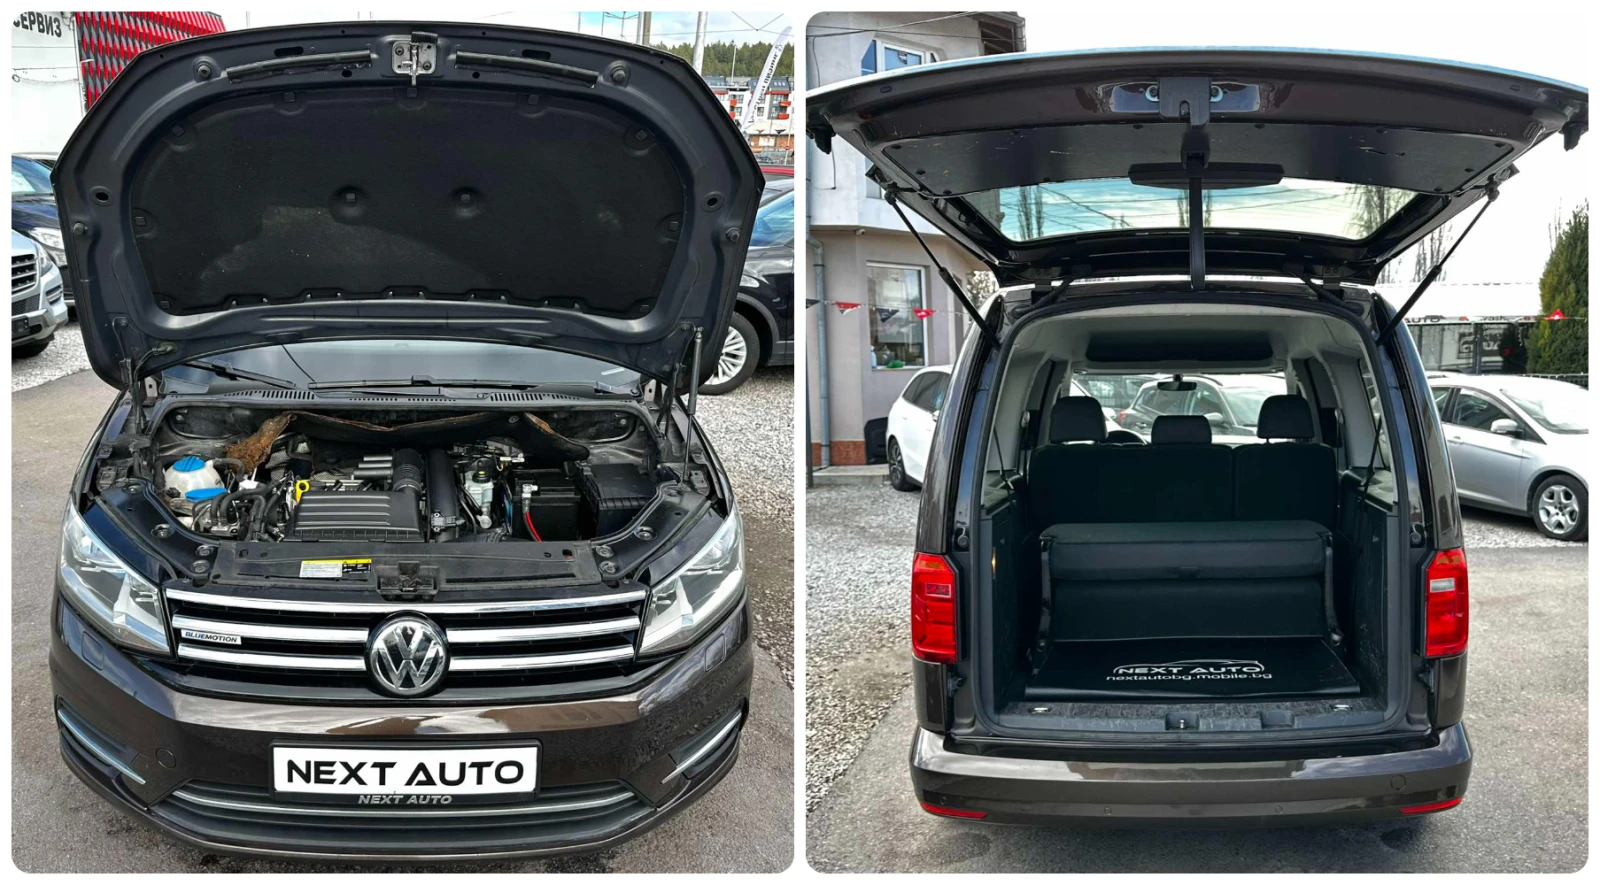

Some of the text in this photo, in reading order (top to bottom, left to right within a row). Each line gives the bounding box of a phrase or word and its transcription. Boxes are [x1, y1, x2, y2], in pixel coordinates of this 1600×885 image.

[185, 631, 238, 643] BLUEMOTION
[1190, 666, 1261, 674] AUTO
[1106, 673, 1273, 681] nextautobg.mobile.bg
[287, 759, 524, 786] NEXT AUTO
[358, 795, 452, 804] NEXT AUTO
